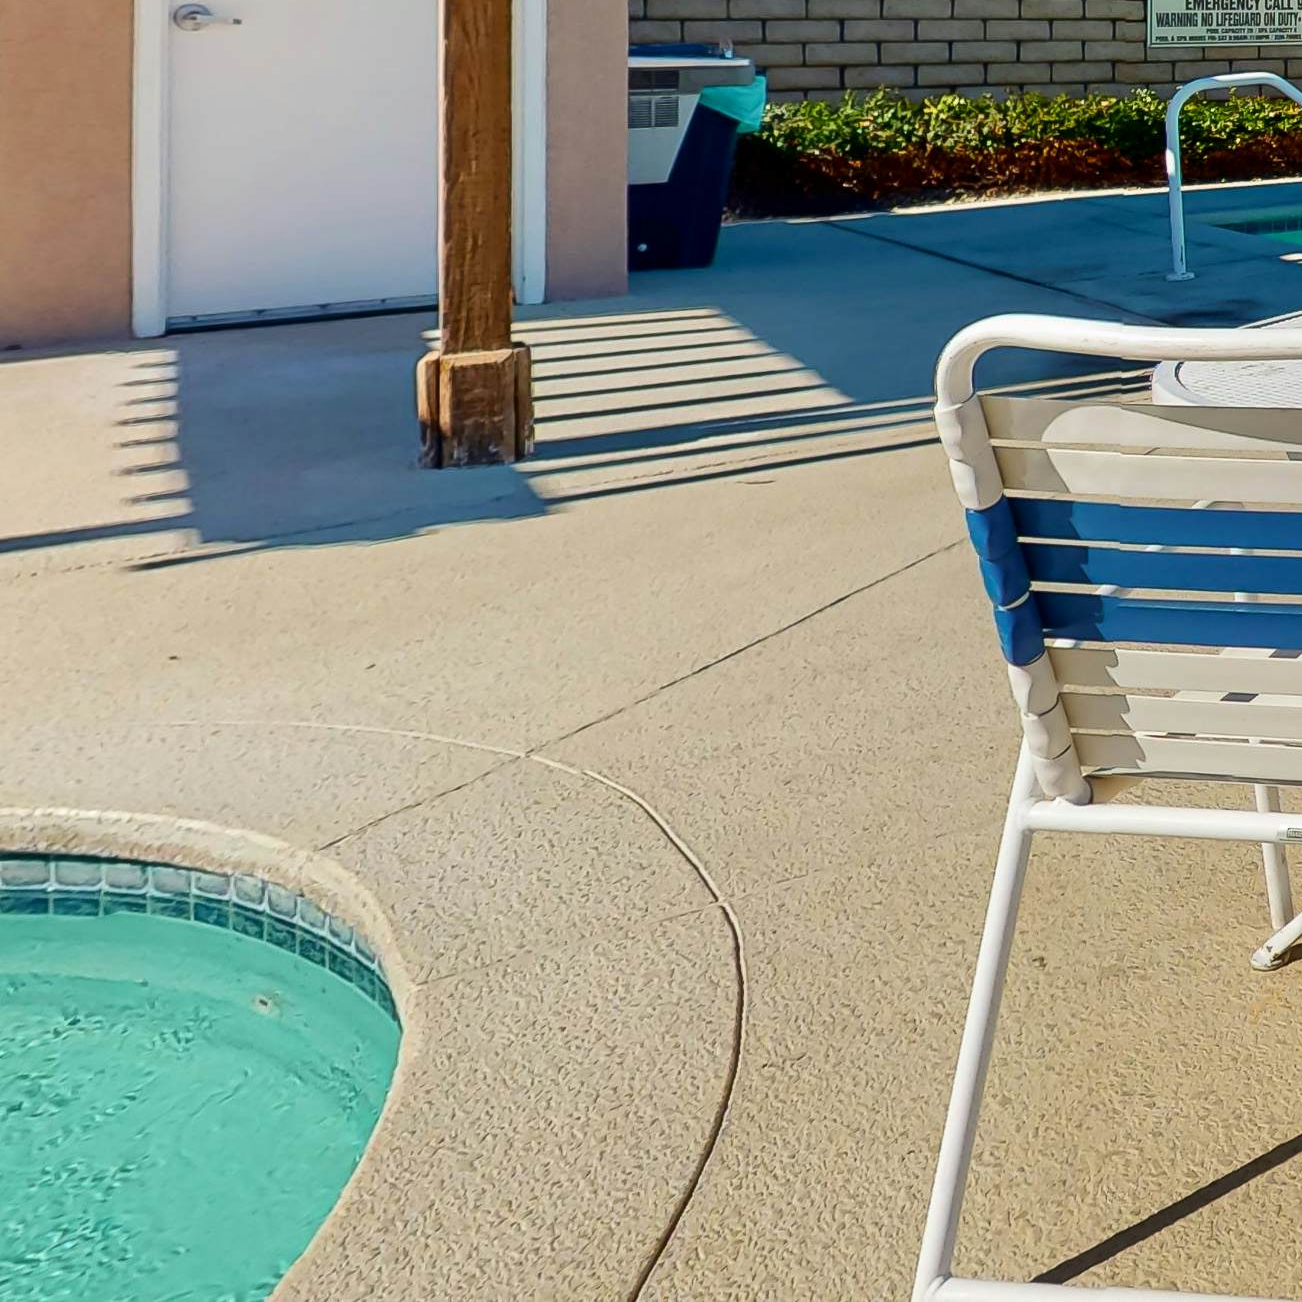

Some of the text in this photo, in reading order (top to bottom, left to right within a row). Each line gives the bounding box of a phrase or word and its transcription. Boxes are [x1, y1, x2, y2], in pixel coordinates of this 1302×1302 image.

[1155, 12, 1198, 27] WARNING
[1201, 12, 1214, 27] NO
[1216, 12, 1262, 27] LIFEGUARD
[1263, 12, 1276, 26] ON
